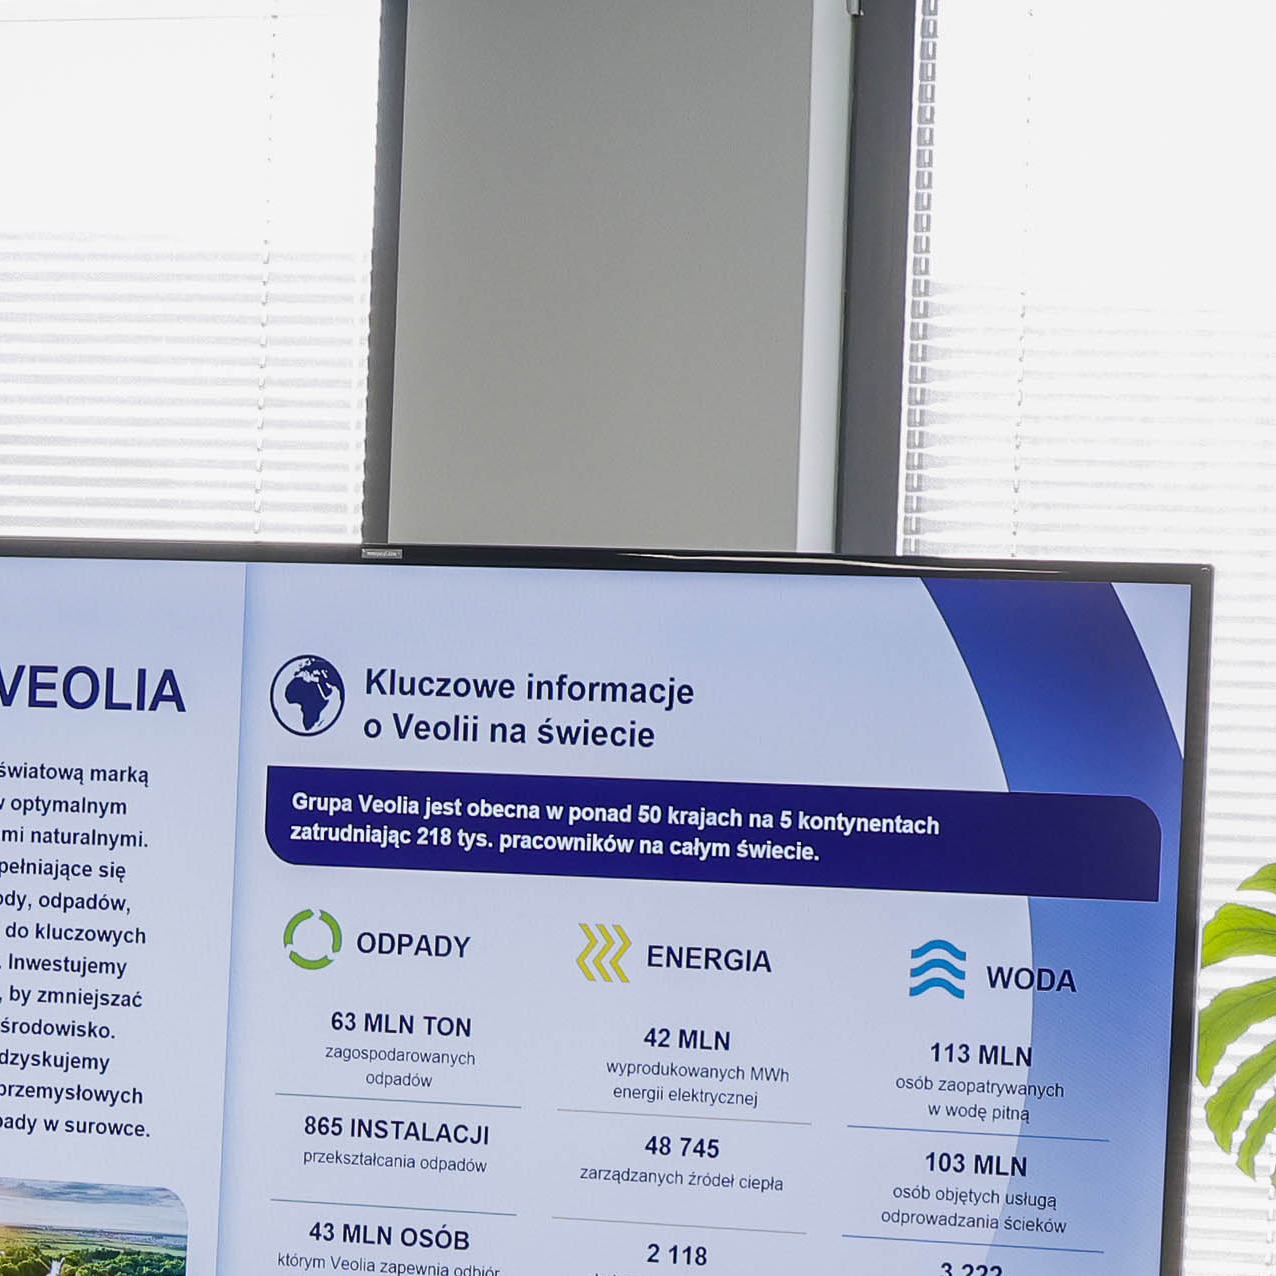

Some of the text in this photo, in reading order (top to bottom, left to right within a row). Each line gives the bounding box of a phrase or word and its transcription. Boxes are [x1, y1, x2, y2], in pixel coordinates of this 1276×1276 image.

[365, 667, 695, 712] Kluczowe informacje
[363, 712, 655, 748] o Veolii na świecie
[89, 765, 149, 788] marką
[10, 795, 128, 819] optymalnym
[293, 792, 940, 836] Grupa Veolia jest obecna w ponad 50 krajach na 5 kontynentach
[30, 827, 148, 852] naturalnymi.
[290, 823, 820, 861] zatrudniając 218 tys. pracowników na całym świecie.
[98, 861, 127, 884] się
[38, 891, 131, 916] odpadów,
[5, 921, 29, 939] do
[35, 922, 146, 948] kluczowych
[356, 931, 471, 959] ODPADY
[8, 952, 127, 980] Inwestujemy
[647, 944, 772, 973] ENERGIA
[986, 965, 1077, 993] WODA
[9, 984, 32, 1007] by
[37, 988, 143, 1010] zmniejszać
[0, 1016, 115, 1039] środowisko.
[331, 1011, 472, 1038] 63 MLN TON
[643, 1027, 731, 1051] 42 MLN
[325, 1046, 476, 1068] zagospodarowanych
[930, 1042, 1033, 1067] 113 MLN
[365, 1071, 433, 1088] odpadów
[606, 1061, 790, 1083] wyprodukowanych MWh
[612, 1086, 758, 1109] energii elektrycznej
[895, 1076, 1065, 1100] osób zaopatrywanych
[928, 1103, 1031, 1125] w wodę pitną
[43, 1118, 60, 1132] w
[64, 1120, 150, 1138] surowce.
[304, 1115, 489, 1146] 865 INSTALACJI
[644, 1135, 720, 1159] 48 745
[303, 1150, 488, 1173] przekształcania odpadów
[924, 1152, 1028, 1177] 103 MLN
[580, 1167, 784, 1193] zarządzanych źródeł ciepła
[892, 1185, 1059, 1211] osób objętych usługą
[881, 1208, 1067, 1234] odprowadzania ścieków
[309, 1221, 470, 1251] 43 MLN OSÓB
[277, 1252, 326, 1272] którym
[330, 1255, 376, 1272] Veolia
[380, 1262, 450, 1276] zapewnia
[646, 1243, 708, 1266] 2 118
